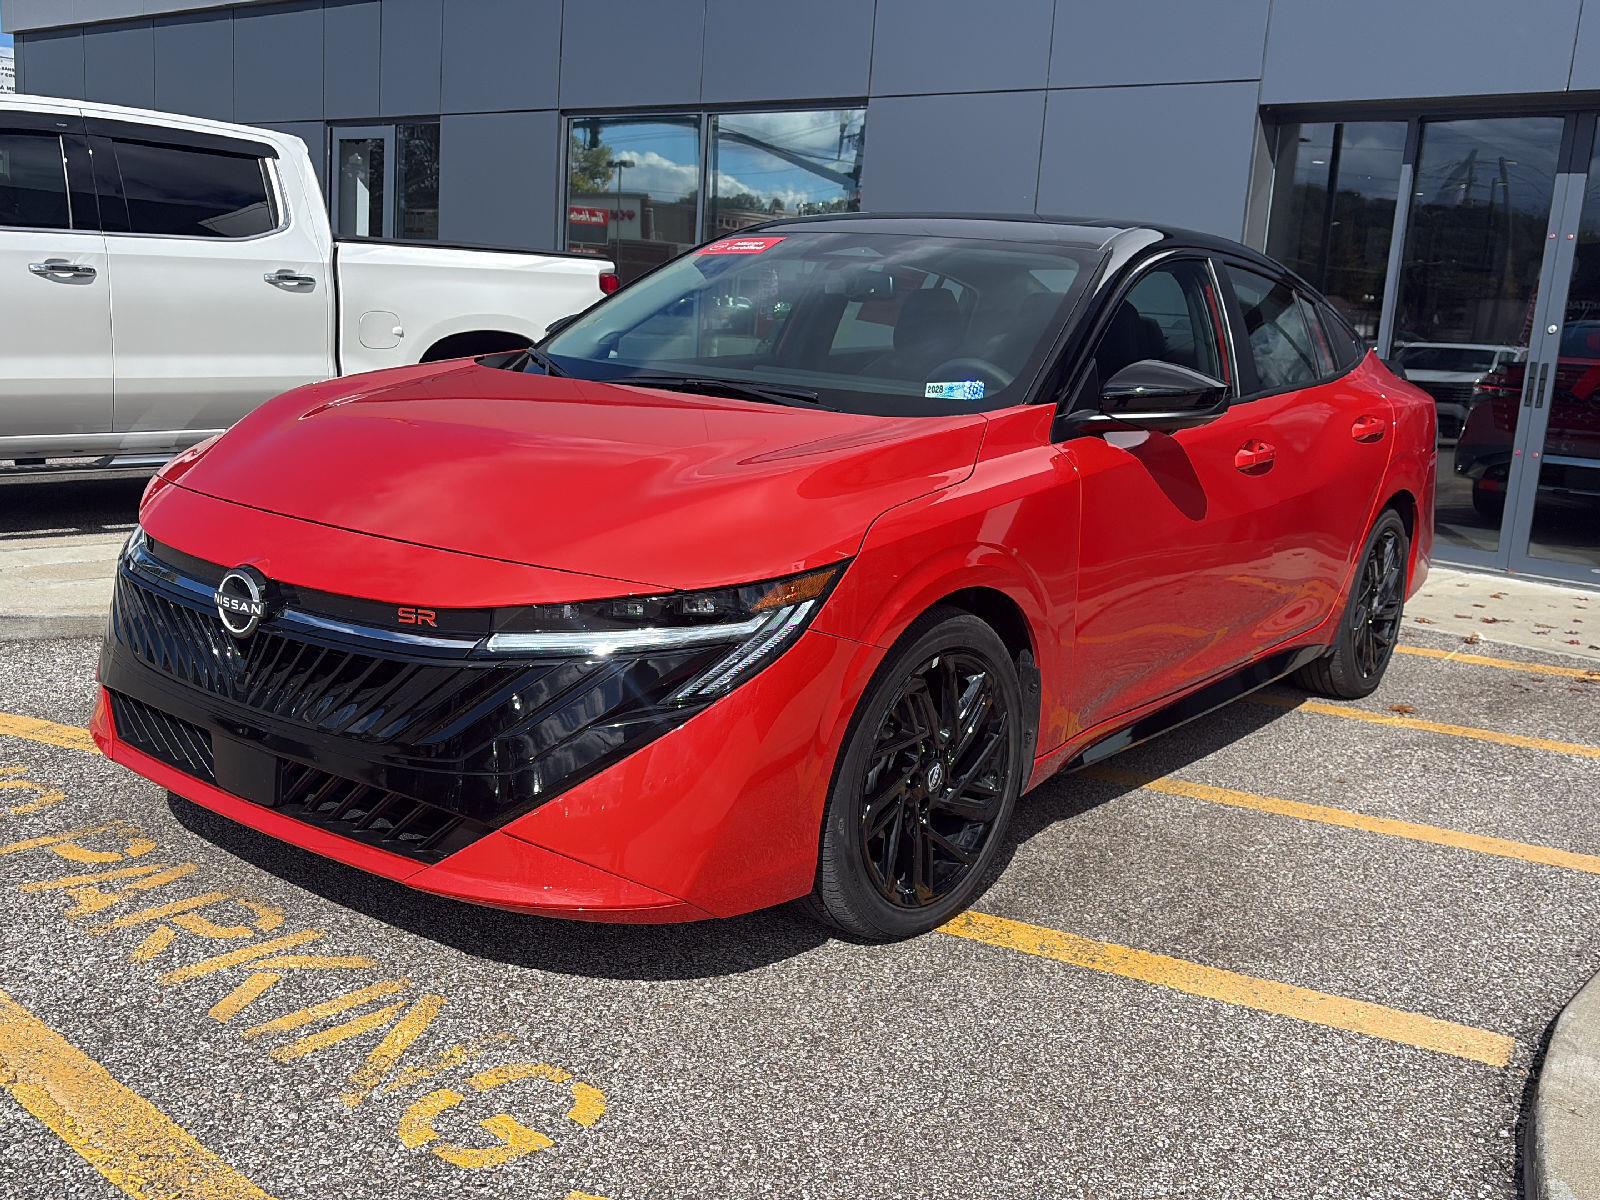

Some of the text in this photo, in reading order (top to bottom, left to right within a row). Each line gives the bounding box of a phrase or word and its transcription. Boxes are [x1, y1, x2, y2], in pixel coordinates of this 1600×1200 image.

[928, 384, 944, 394] 2028
[214, 592, 262, 614] NISSAN
[398, 608, 438, 627] SR
[0, 820, 607, 1169] PARKING
